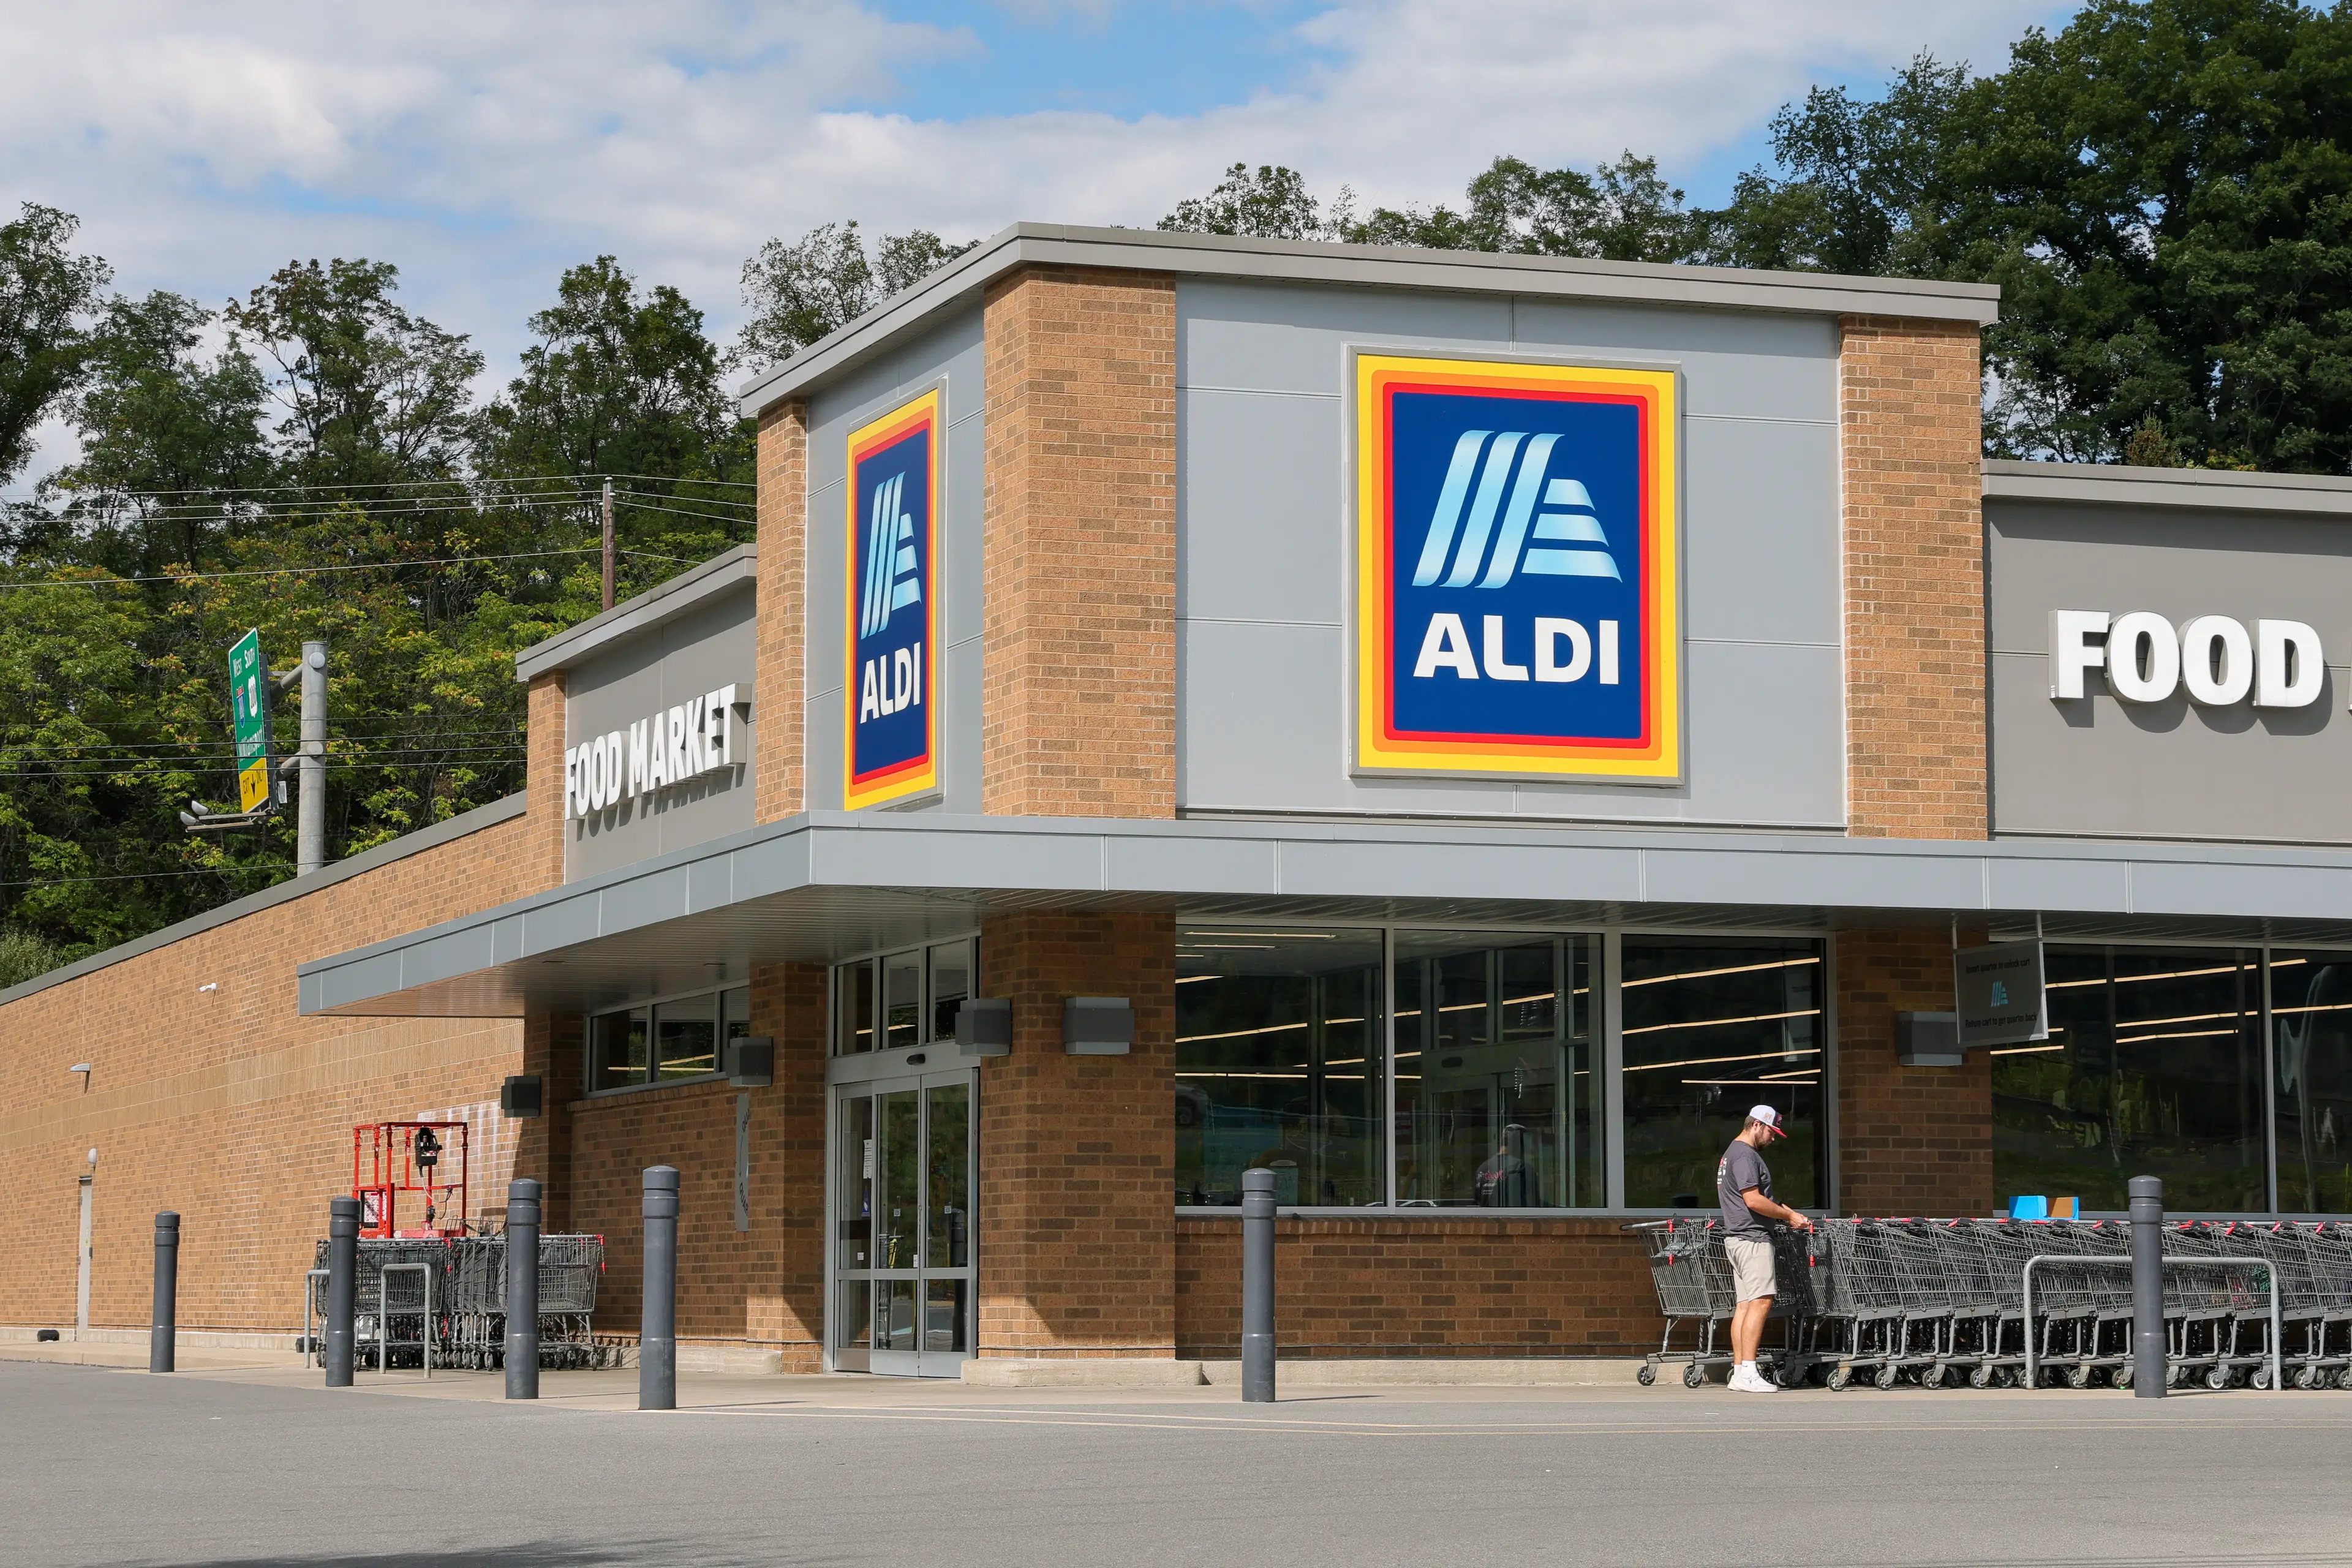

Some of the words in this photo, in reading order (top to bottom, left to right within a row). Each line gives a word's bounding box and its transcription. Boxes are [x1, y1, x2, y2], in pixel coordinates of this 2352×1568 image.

[860, 641, 921, 724] ALDI
[1412, 612, 1619, 685] ALDI
[2049, 608, 2324, 708] FOOD
[565, 730, 624, 821] FOOD
[628, 682, 739, 798] MARKET
[1966, 964, 1980, 974] Insert
[1980, 962, 1997, 974] quarter
[1999, 961, 2003, 970] to
[2003, 958, 2020, 968] unlock
[2020, 957, 2030, 967] cart
[1965, 1019, 1981, 1028] Return
[1982, 1017, 1992, 1027] cart
[2007, 1014, 2024, 1026] quarter
[2025, 1012, 2037, 1022] back
